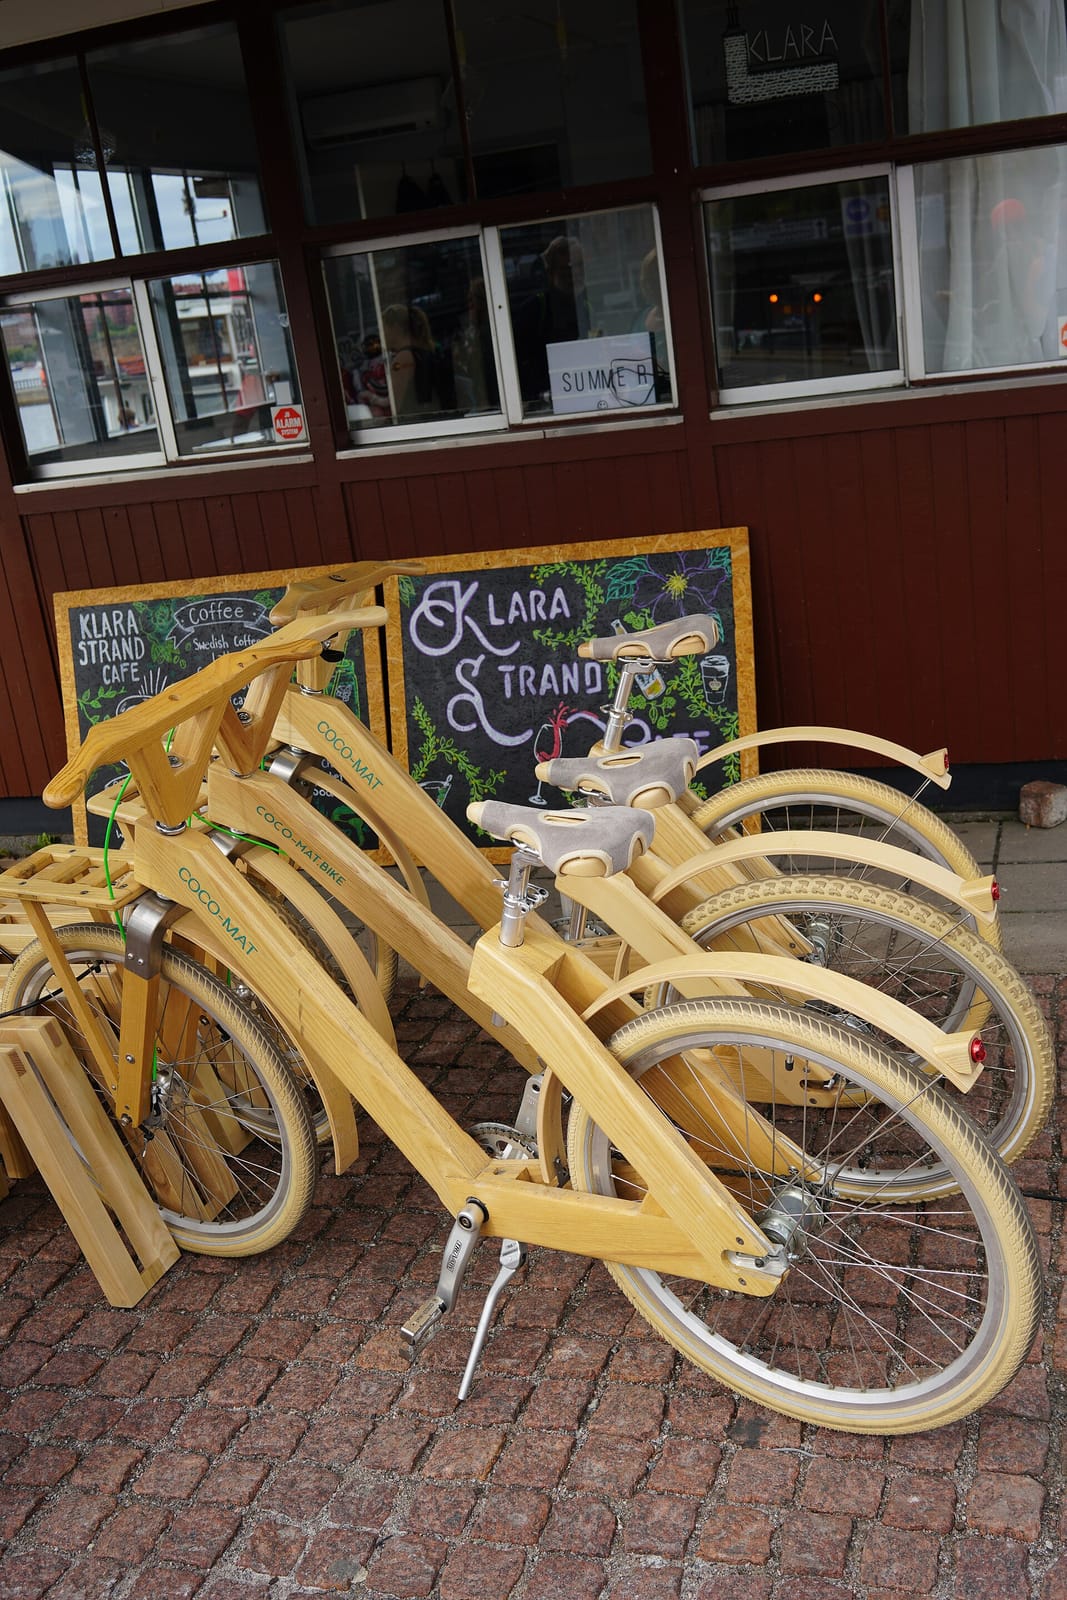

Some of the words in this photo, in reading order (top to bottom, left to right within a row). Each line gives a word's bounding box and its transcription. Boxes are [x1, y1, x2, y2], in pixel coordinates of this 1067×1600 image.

[745, 18, 839, 64] KLARA
[561, 364, 648, 392] SUMMER
[276, 417, 302, 428] ALARM
[79, 609, 139, 640] KLARA
[188, 601, 244, 625] Coffee
[409, 580, 571, 656] KLARA
[78, 636, 145, 666] STRAND
[192, 633, 230, 651] Swedish
[102, 662, 140, 685] CAFE
[447, 654, 604, 747] STRAND
[316, 720, 384, 790] COCO-MAT
[256, 805, 347, 887] COCO-MAT.BIKE
[178, 866, 259, 956] COCO-MAT
